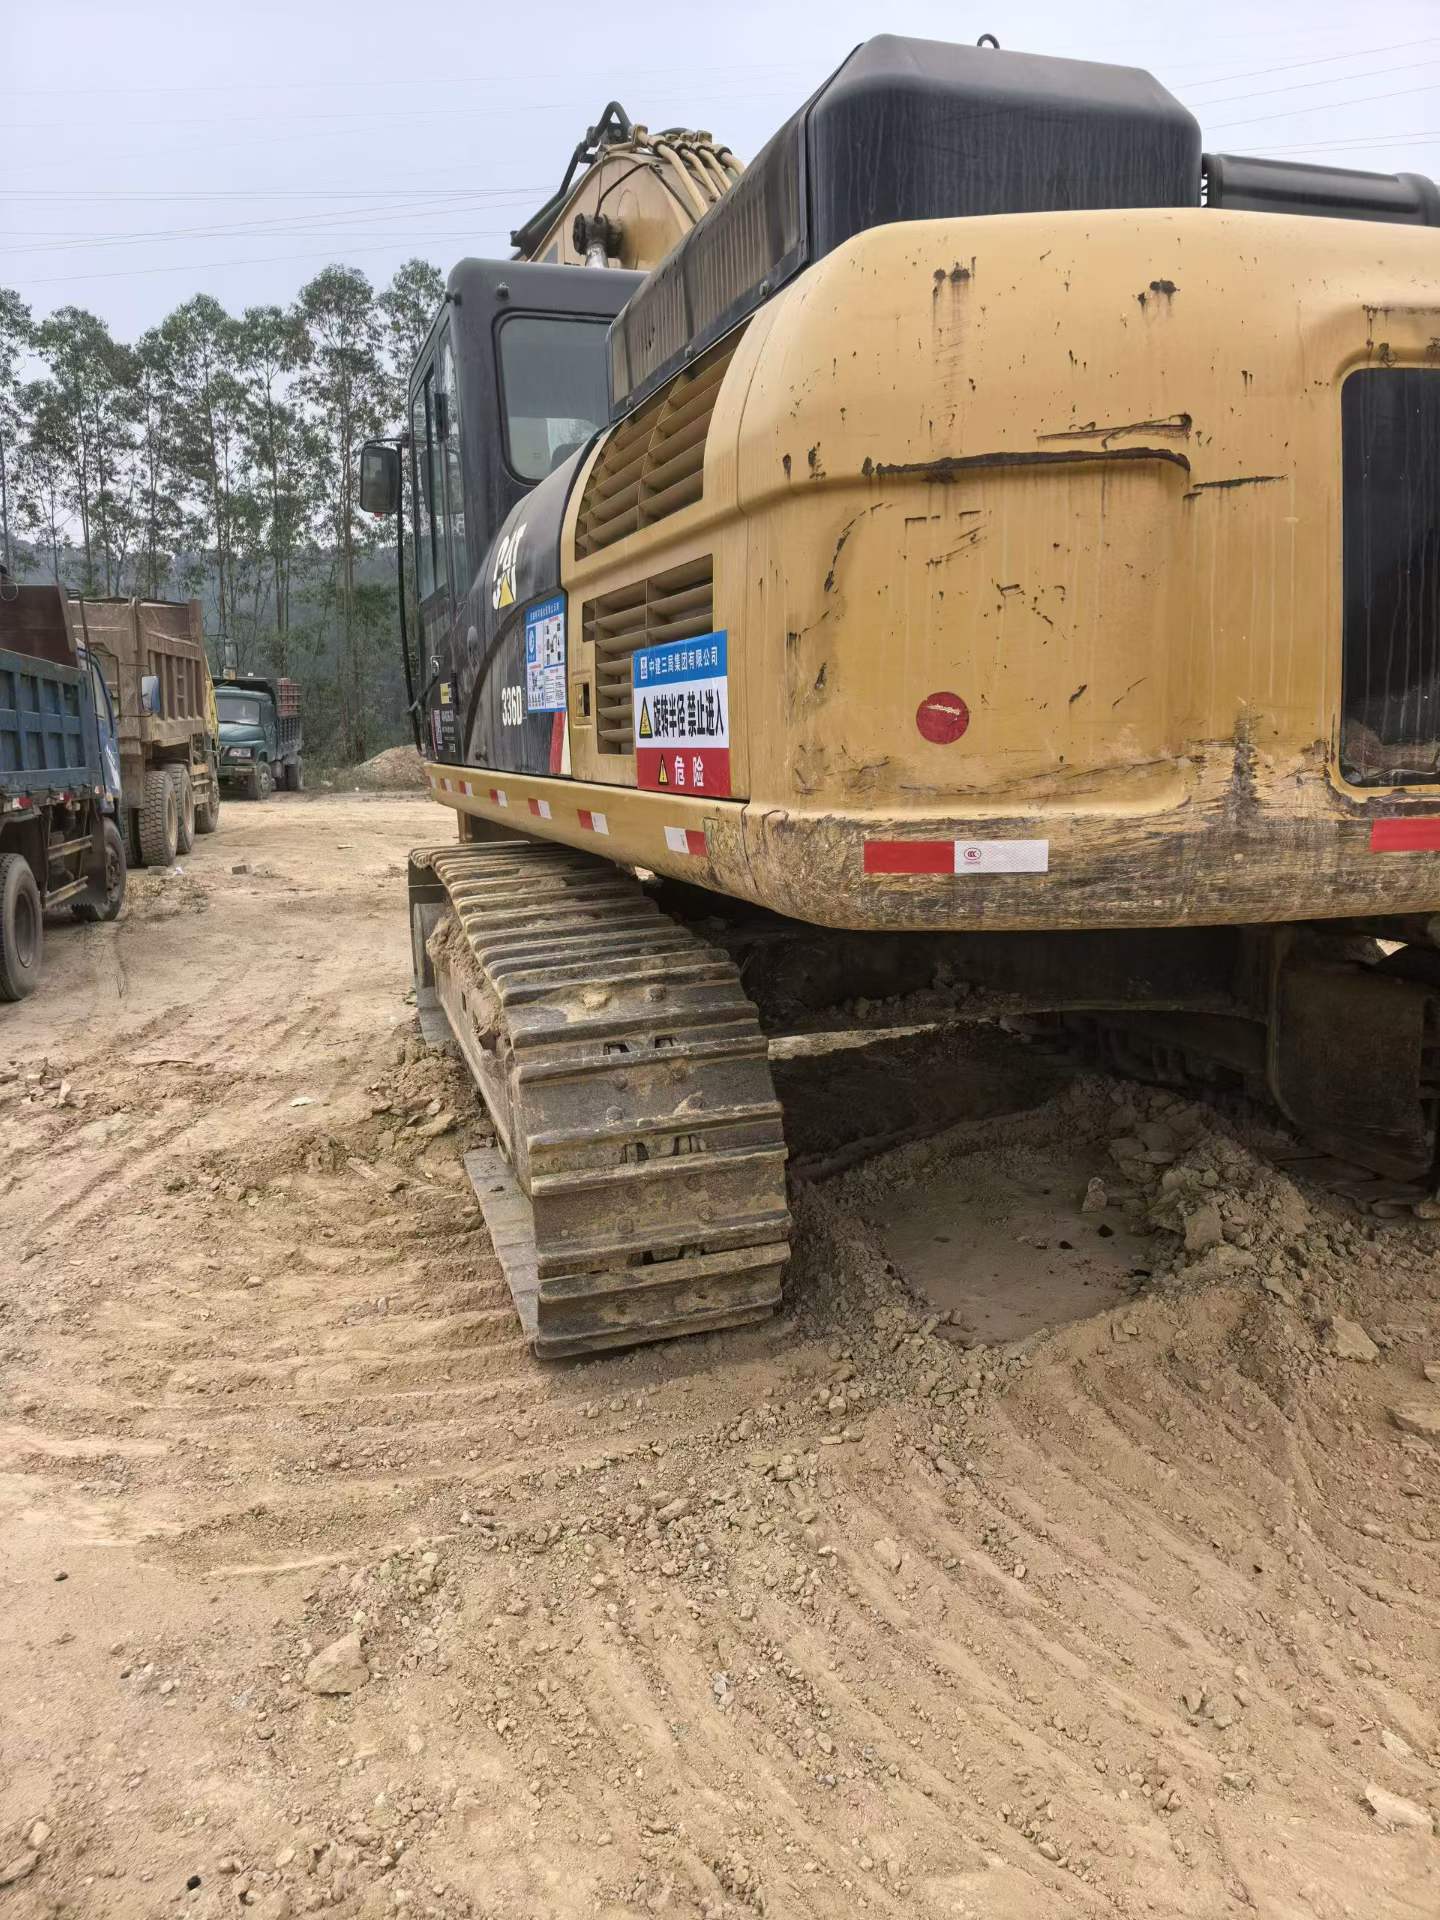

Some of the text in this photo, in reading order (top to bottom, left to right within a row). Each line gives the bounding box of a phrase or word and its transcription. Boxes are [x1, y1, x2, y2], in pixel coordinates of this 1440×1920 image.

[493, 524, 527, 609] CAT
[649, 646, 718, 679] 中建三局集团有限公司
[502, 686, 523, 727] 336D
[653, 689, 724, 738] 旋转半径 禁止进入
[674, 754, 704, 787] 危险
